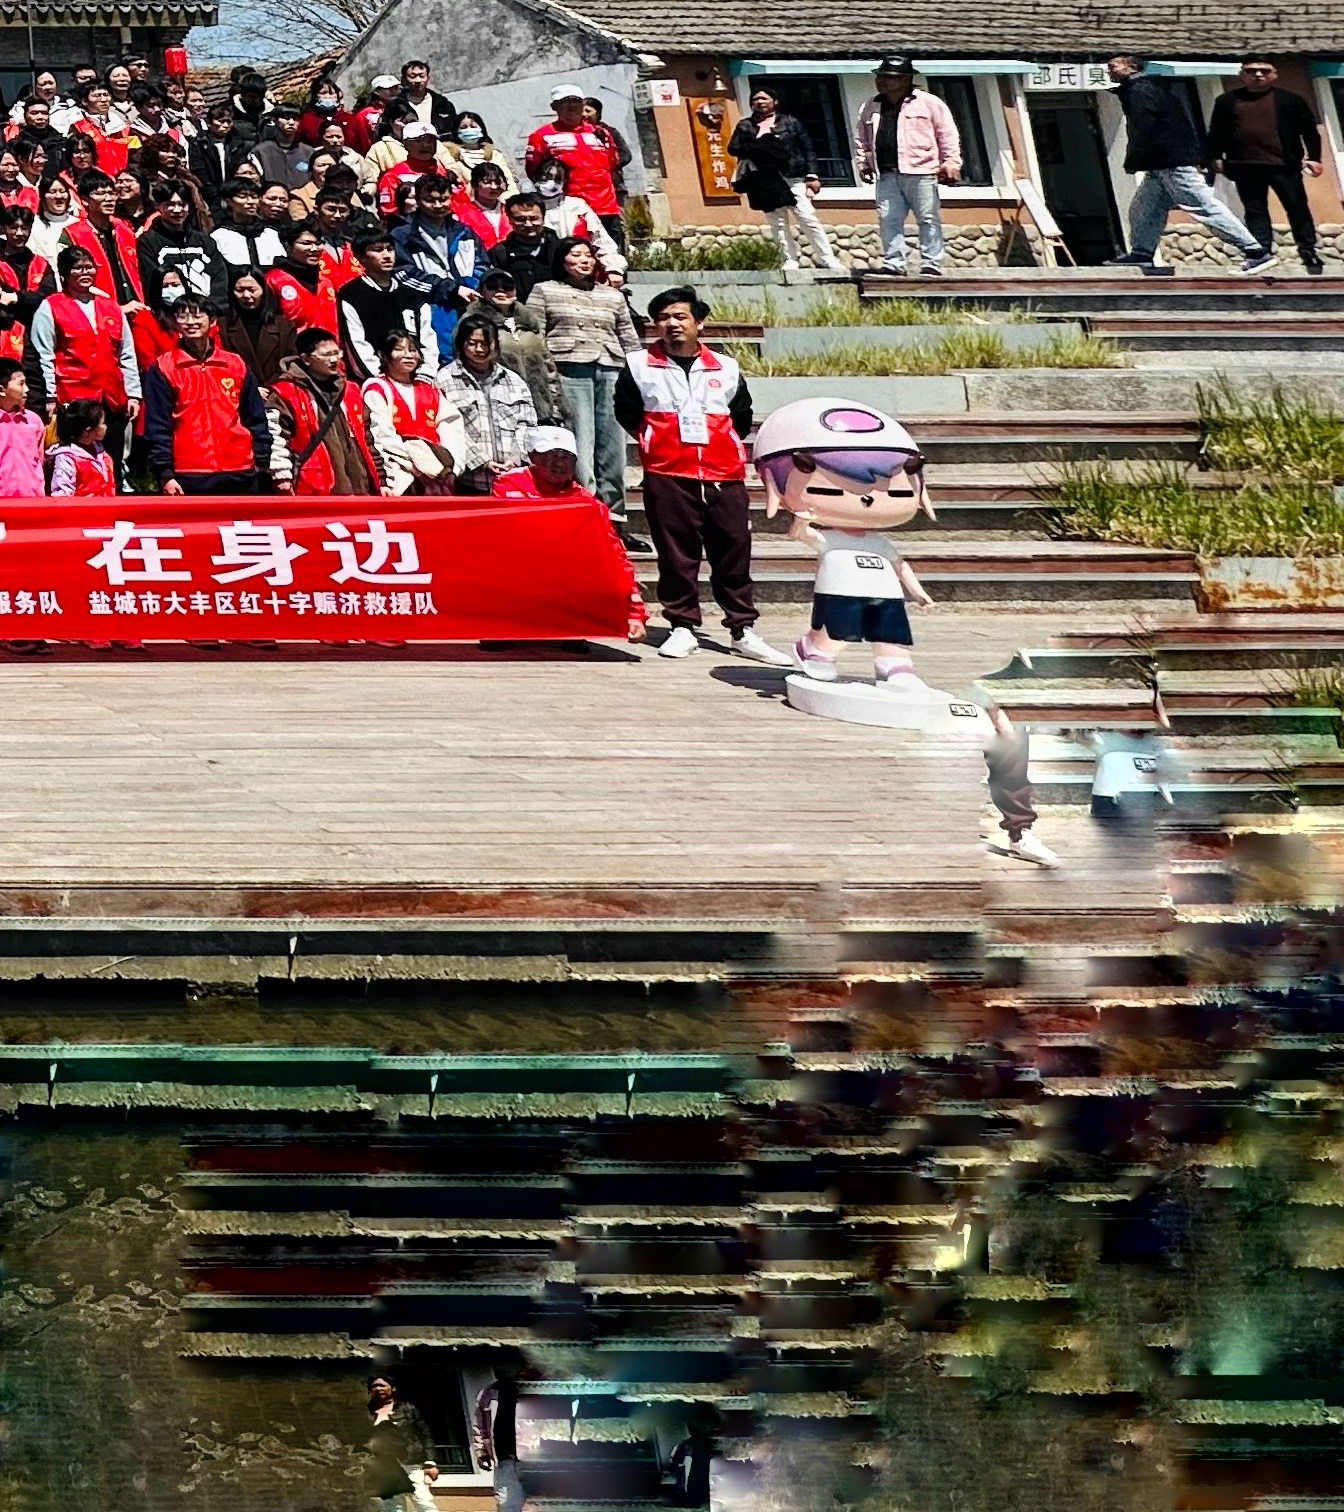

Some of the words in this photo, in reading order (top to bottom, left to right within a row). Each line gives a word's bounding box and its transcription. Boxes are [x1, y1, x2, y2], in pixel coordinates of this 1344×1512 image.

[88, 590, 438, 616] 盐城市大丰区红十字赈济救援队
